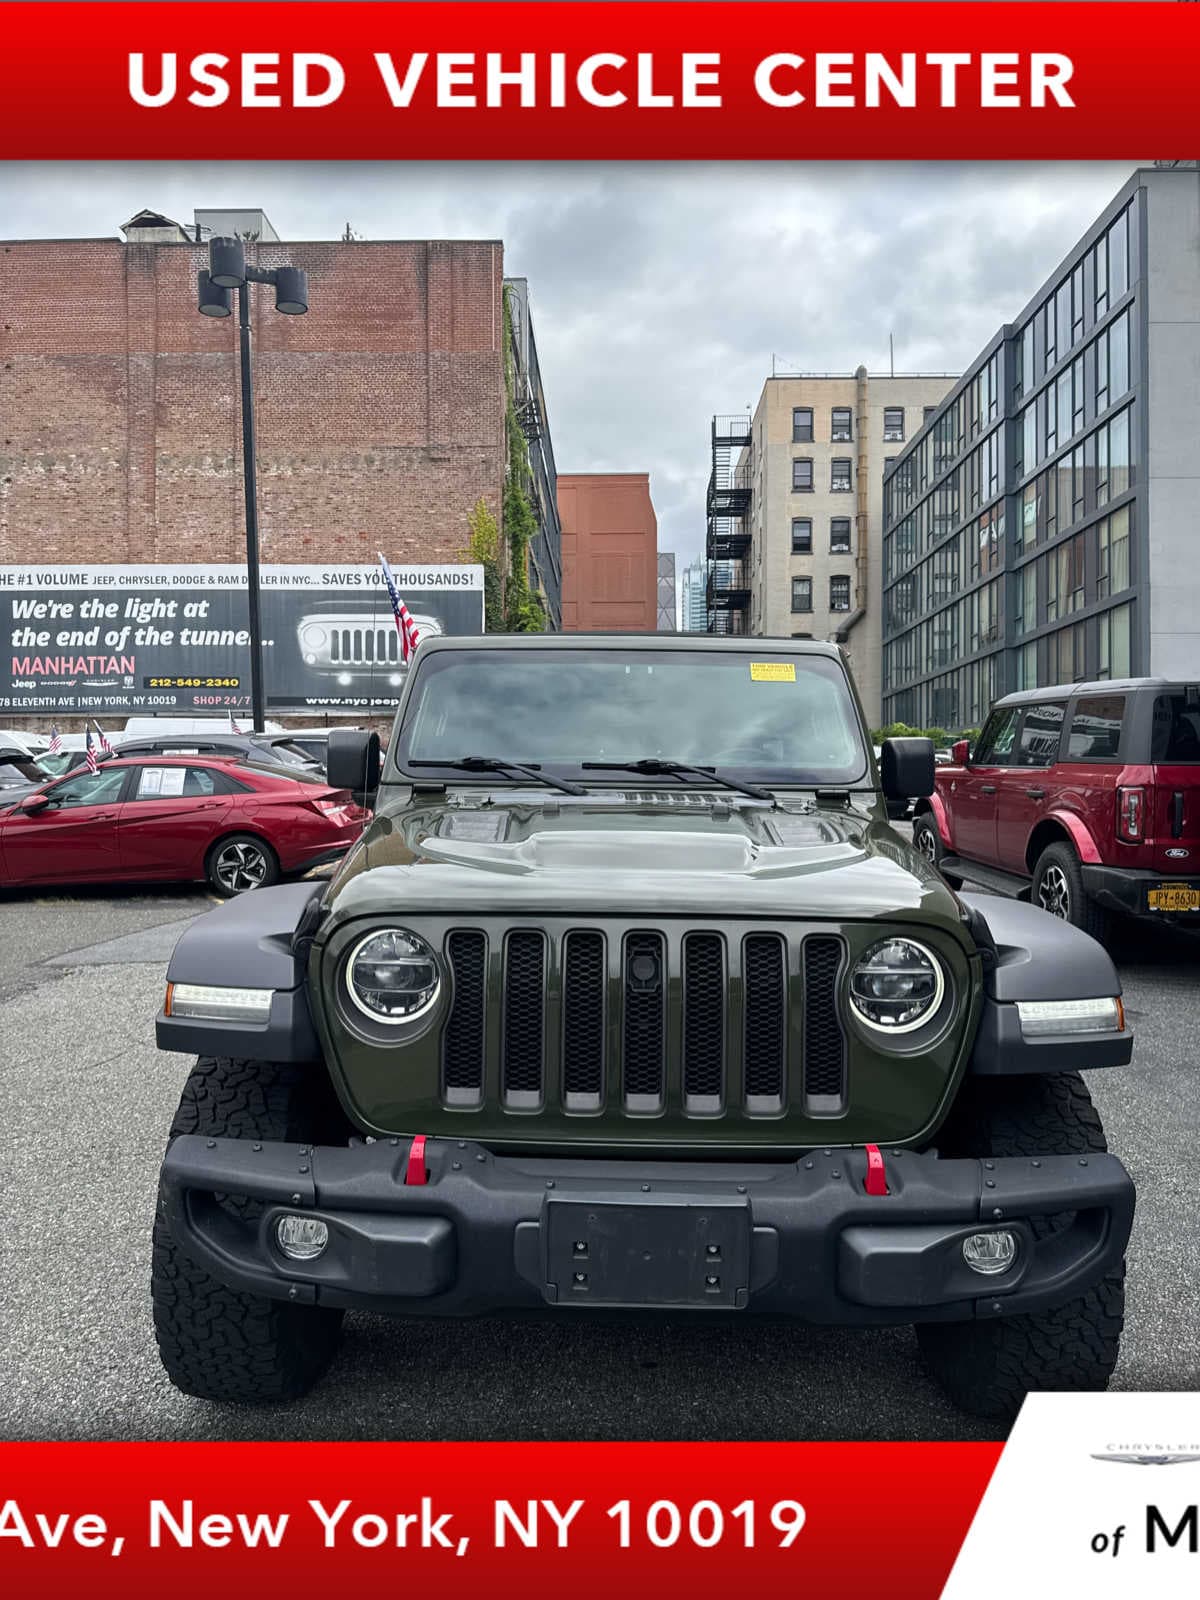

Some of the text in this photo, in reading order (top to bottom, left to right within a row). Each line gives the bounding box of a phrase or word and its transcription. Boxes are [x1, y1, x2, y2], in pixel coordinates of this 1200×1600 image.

[18, 574, 32, 585] #1
[36, 574, 88, 584] VOLUME
[92, 576, 116, 586] JEEP,
[119, 576, 170, 586] CHRYSLER,
[172, 576, 206, 584] DODGE
[208, 576, 216, 584] &
[218, 576, 239, 584] RAM
[242, 576, 278, 584] DLER
[280, 576, 290, 584] IN
[322, 574, 362, 585] SAVES
[392, 574, 474, 585] THOUSANDS!
[12, 598, 210, 623] We're the light at
[12, 627, 50, 647] the
[56, 626, 101, 646] end
[105, 626, 132, 652] of
[134, 627, 174, 646] the
[12, 656, 136, 676] MANHATTAN
[12, 680, 36, 689] Jeep
[150, 678, 239, 687] 212-549-2340
[12, 697, 56, 706] ELEVENTH
[58, 696, 74, 706] AVE
[104, 696, 131, 706] YORK,
[134, 696, 145, 704] NY
[148, 696, 176, 704] 10019
[193, 696, 250, 706] SHOP 24/7
